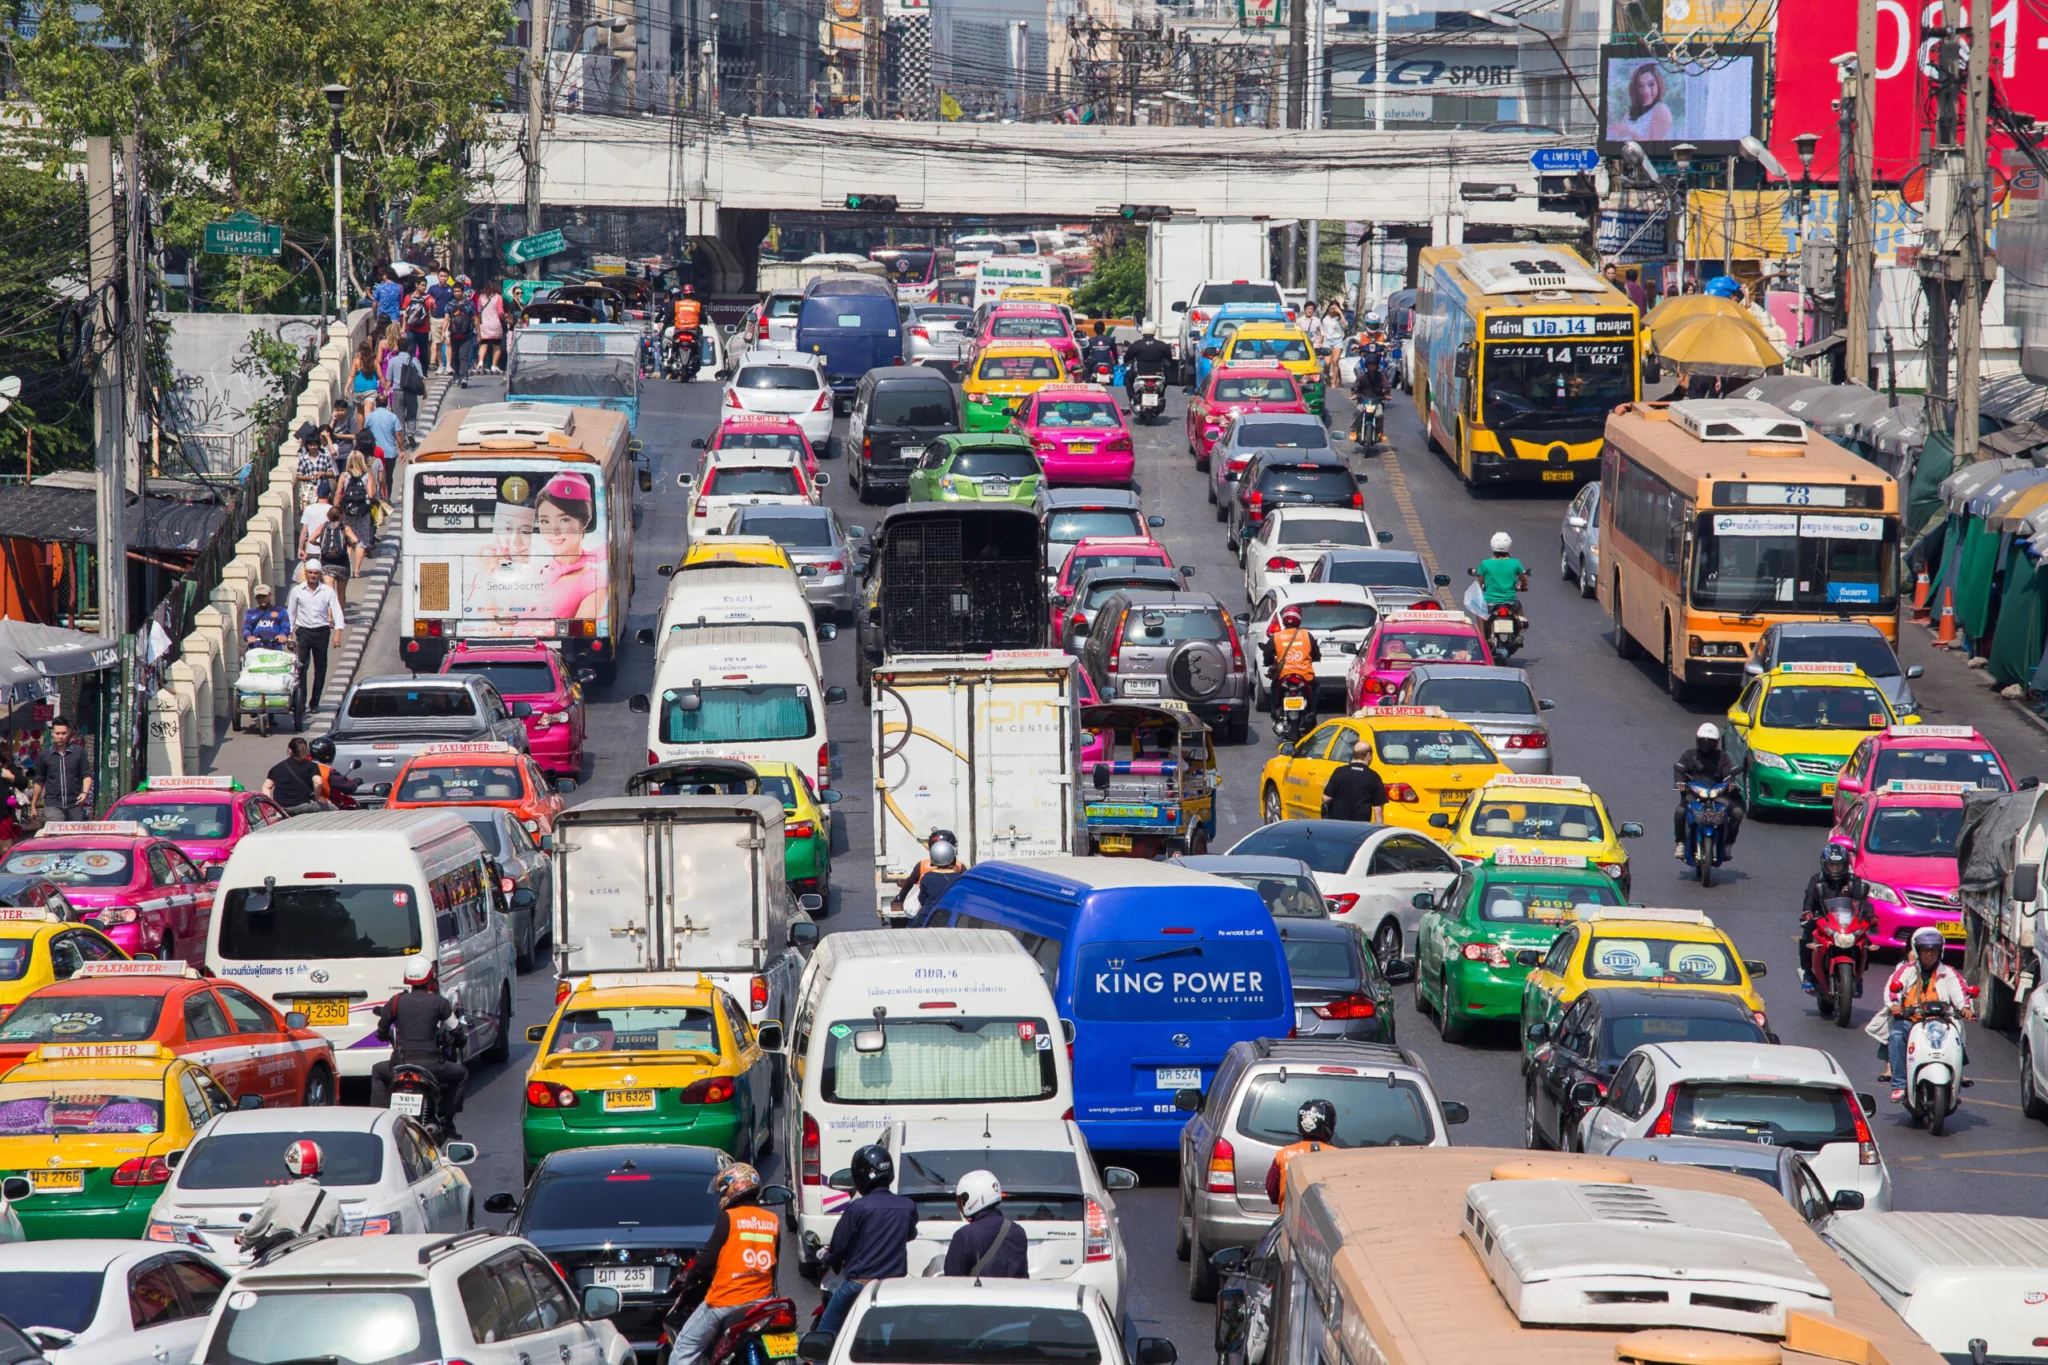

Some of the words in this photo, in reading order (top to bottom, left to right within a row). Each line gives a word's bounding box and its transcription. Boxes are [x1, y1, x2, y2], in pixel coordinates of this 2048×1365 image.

[1450, 65, 1515, 85] SPORT
[1367, 109, 1426, 118] Wolesaler
[1546, 347, 1572, 363] 14
[1785, 486, 1810, 505] 73
[431, 504, 475, 514] 7-55054
[444, 516, 462, 525] 505
[486, 581, 511, 591] Seoul
[514, 581, 544, 591] Secret
[91, 649, 118, 667] VISA
[1792, 663, 1846, 672] TAXI-METER
[1165, 702, 1184, 710] TAXI
[1374, 707, 1426, 716] TAXI-METER
[438, 743, 490, 752] TAXI-METER
[158, 778, 215, 788] TAXI-METER
[1508, 775, 1563, 785] TAXI-METER
[1904, 783, 1963, 792] TAXI-METER
[57, 823, 117, 833] TAXI-METER
[1508, 855, 1567, 866] TAXI-METER
[1532, 900, 1573, 908] 4999
[95, 963, 162, 973] TAXI-METER
[285, 967, 294, 975] 15
[1096, 972, 1164, 993] KING
[1173, 971, 1264, 993] POWER
[1021, 1024, 1032, 1035] 19
[616, 1035, 656, 1044] 31690
[60, 1046, 92, 1057] TAXI
[95, 1044, 138, 1057] METER
[1175, 1069, 1199, 1080] 5274
[626, 1091, 651, 1101] 6325
[1089, 1105, 1143, 1114] www.kingpower.com
[52, 1170, 80, 1183] 2766
[624, 1269, 646, 1281] 235
